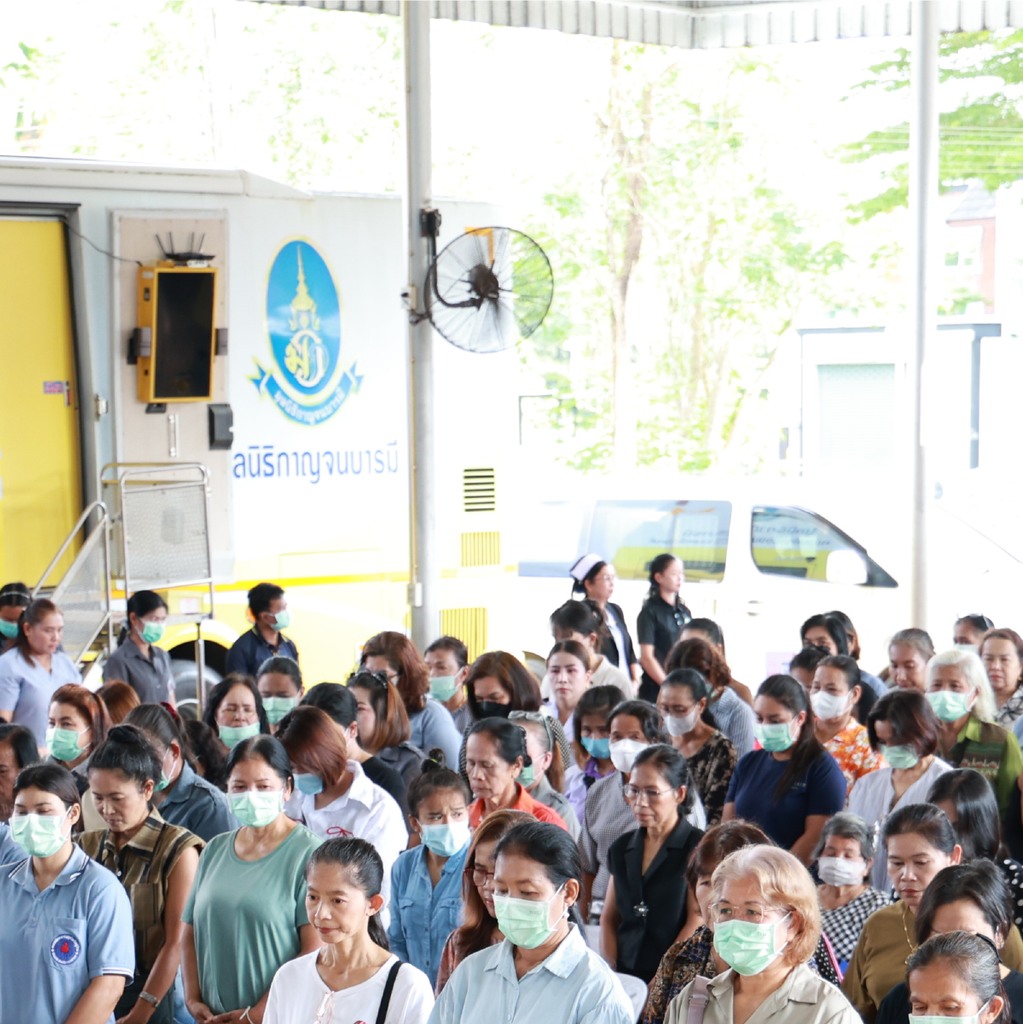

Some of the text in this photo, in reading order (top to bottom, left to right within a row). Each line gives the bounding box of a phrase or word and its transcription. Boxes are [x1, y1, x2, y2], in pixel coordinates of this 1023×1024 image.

[232, 440, 399, 484] ลนิธิกาญจนบารมี
